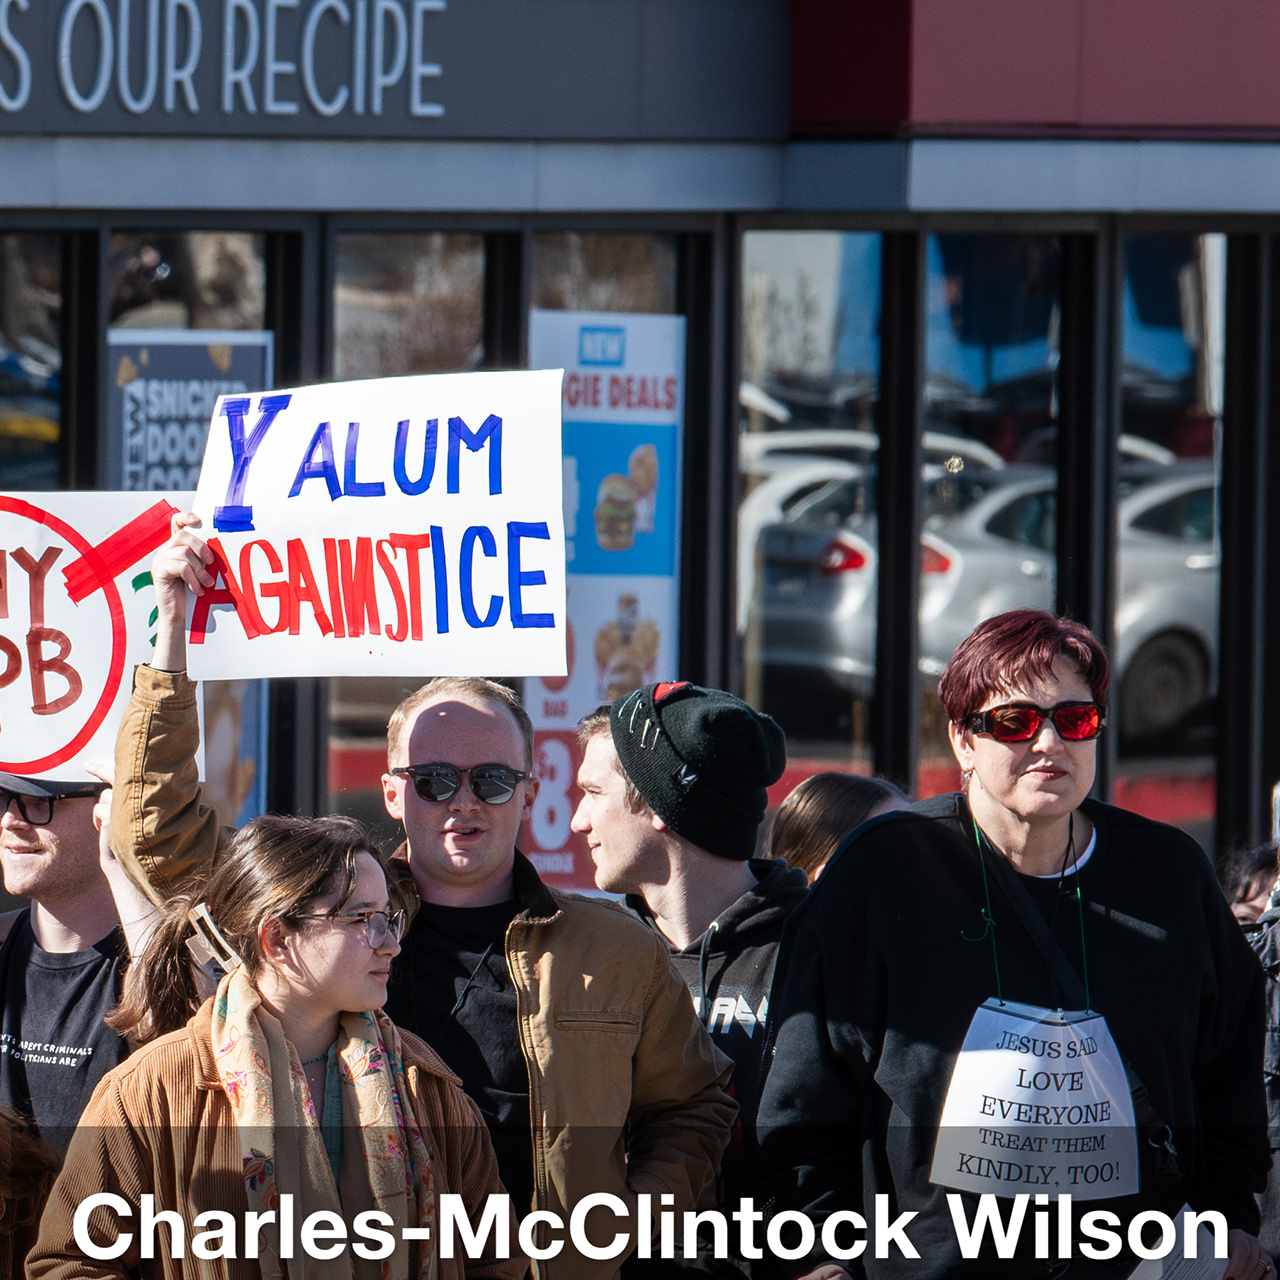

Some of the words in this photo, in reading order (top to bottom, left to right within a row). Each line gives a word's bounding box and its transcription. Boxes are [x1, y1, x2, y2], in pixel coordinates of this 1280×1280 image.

[57, 0, 202, 113] OUR
[222, 0, 445, 117] RECIPE
[562, 371, 602, 410] GIE
[607, 374, 678, 411] DEALS
[212, 394, 293, 533] Y
[288, 413, 503, 502] ALUM
[430, 520, 556, 635] ICE
[43, 1043, 93, 1056] CRIMINALS
[996, 1030, 1062, 1060] JESUS
[58, 1057, 78, 1067] ARE
[1015, 1067, 1084, 1092] LOVE
[978, 1094, 1112, 1126] EVERYONE
[978, 1127, 1048, 1153] TREAT
[1052, 1134, 1106, 1154] THEM
[956, 1152, 1060, 1188] KINDLY,
[1067, 1161, 1121, 1186] TOO!
